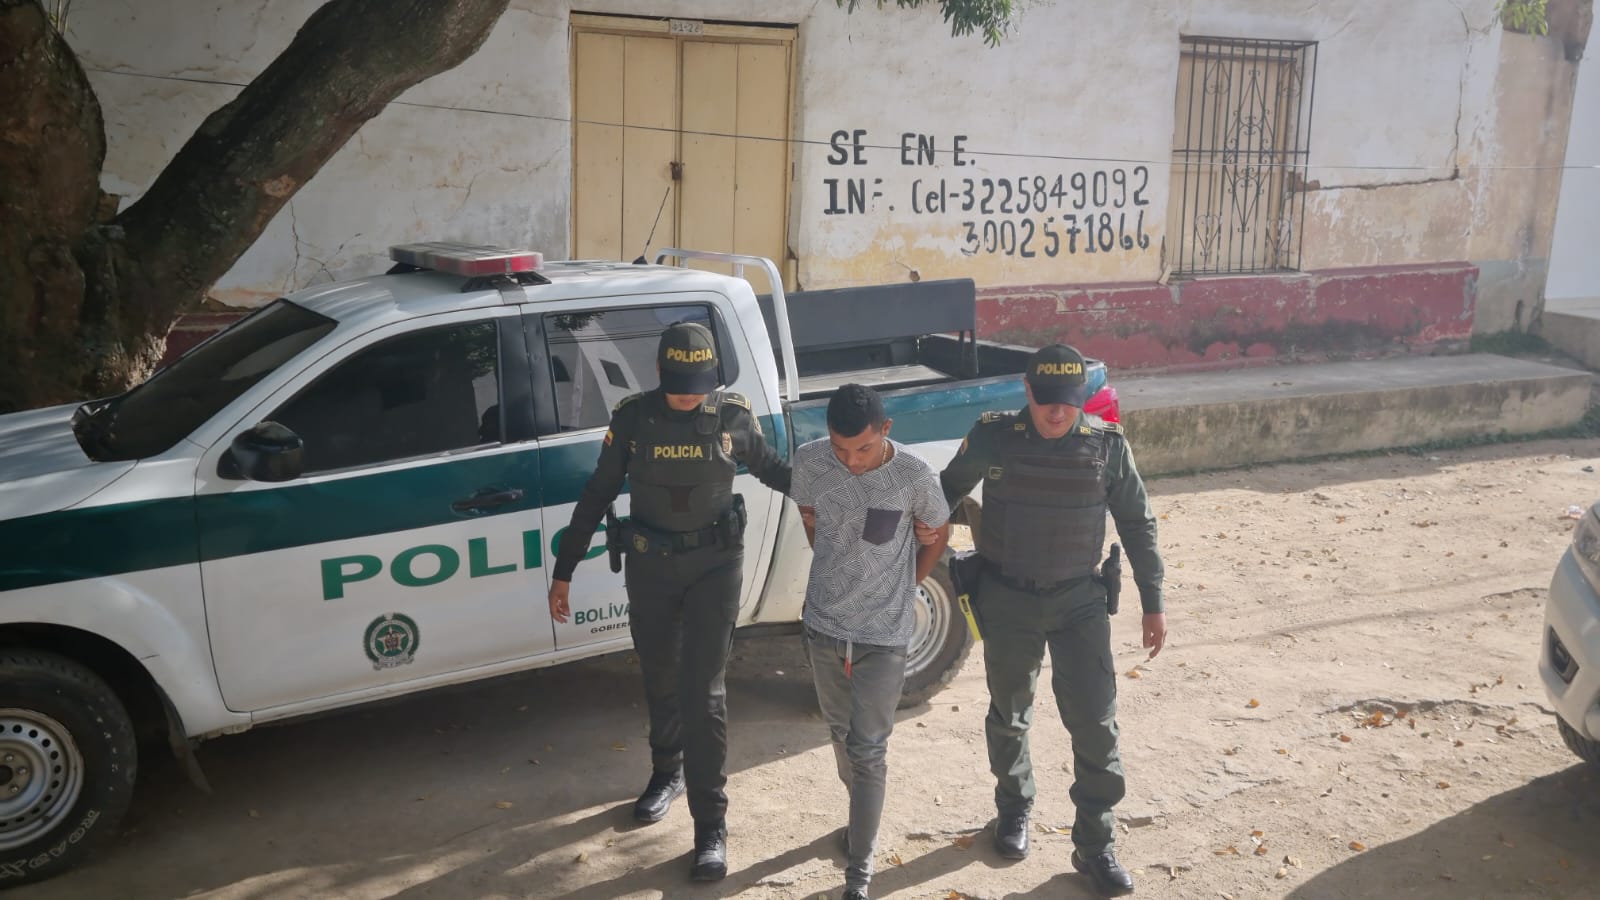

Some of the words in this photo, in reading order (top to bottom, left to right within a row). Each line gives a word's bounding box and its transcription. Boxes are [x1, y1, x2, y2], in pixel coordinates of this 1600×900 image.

[827, 129, 868, 166] SE
[960, 210, 1150, 258] 3002571866
[666, 347, 713, 363] POLICIA
[1036, 362, 1082, 375] POLICIA
[654, 445, 703, 459] POLICIA
[321, 515, 630, 601] POLIC
